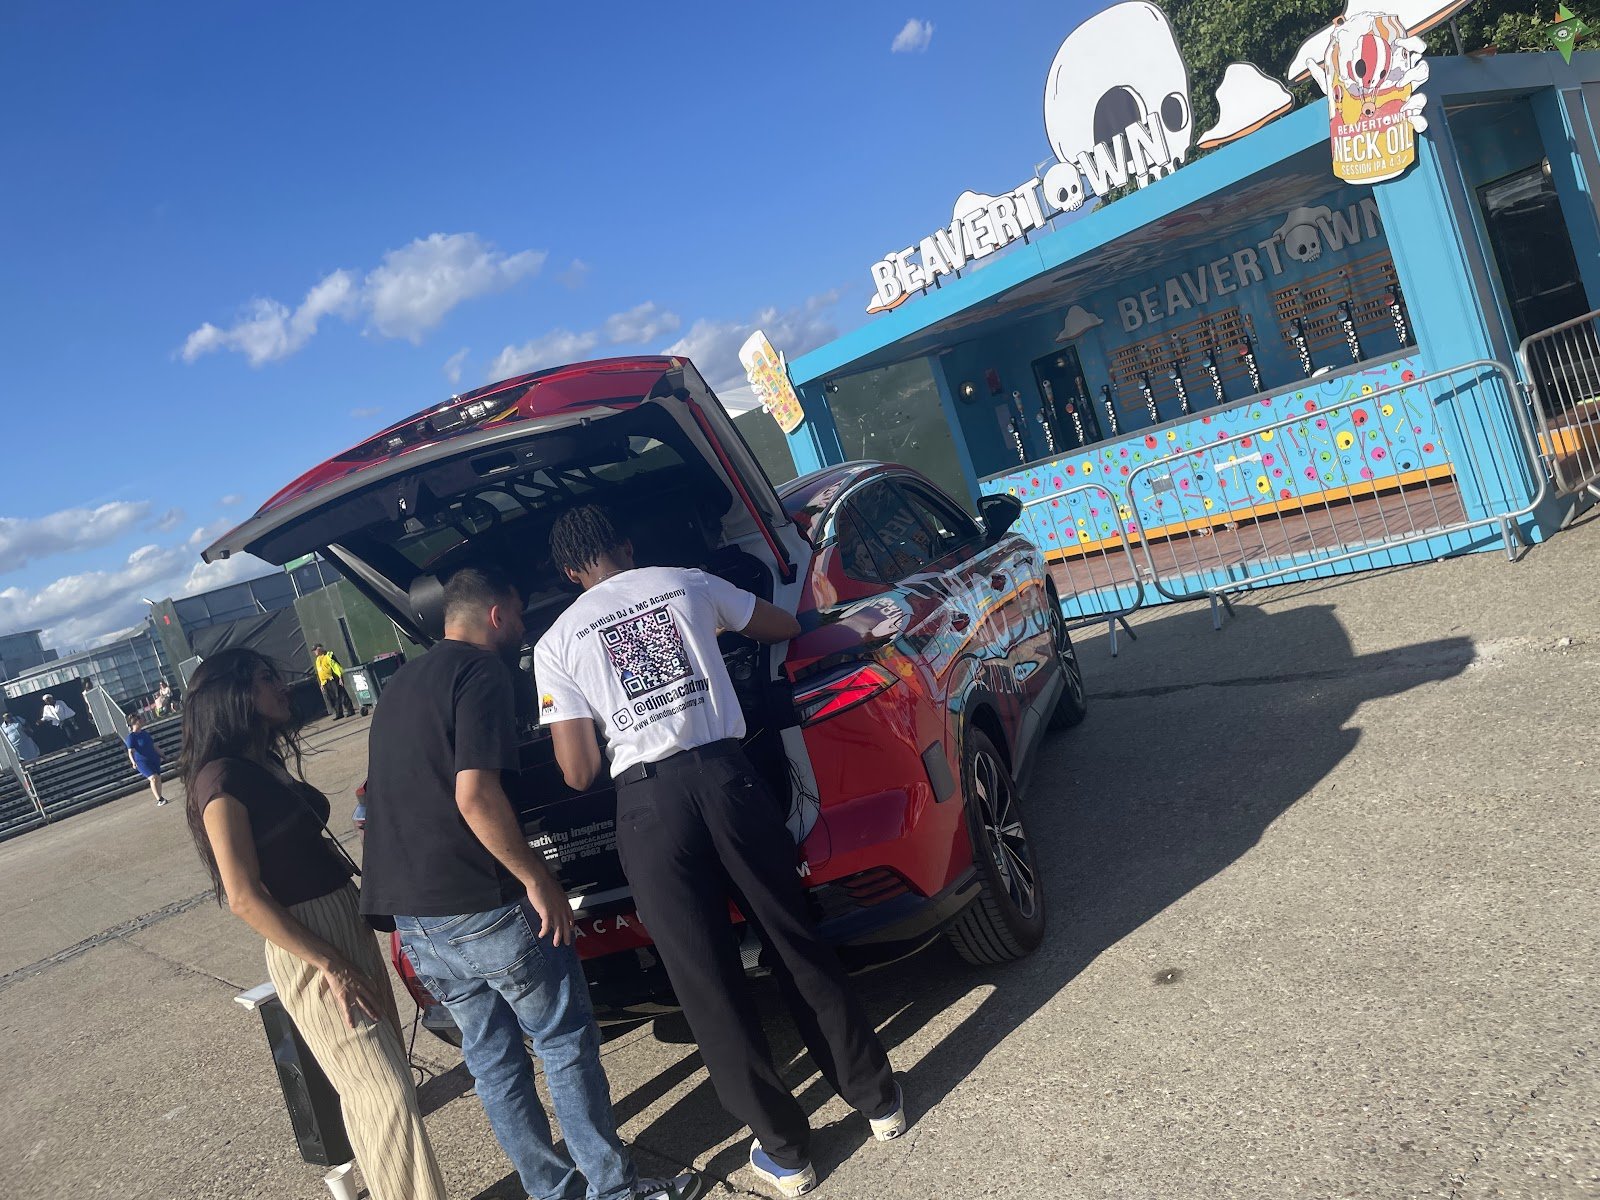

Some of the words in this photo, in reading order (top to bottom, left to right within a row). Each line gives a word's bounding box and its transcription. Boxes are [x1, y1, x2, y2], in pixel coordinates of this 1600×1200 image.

[1338, 112, 1406, 135] BEAVERTOWN
[1334, 132, 1382, 163] NECK
[1386, 121, 1413, 155] OIL
[1341, 163, 1372, 176] SESSION
[1374, 160, 1387, 172] IPA
[871, 111, 1171, 307] BEAVERTOWN
[575, 628, 590, 640] The
[589, 612, 616, 631] British
[615, 609, 628, 619] DJ
[628, 607, 635, 615] &
[634, 600, 649, 612] MC
[649, 588, 686, 606] Academy
[570, 819, 614, 838] inspires
